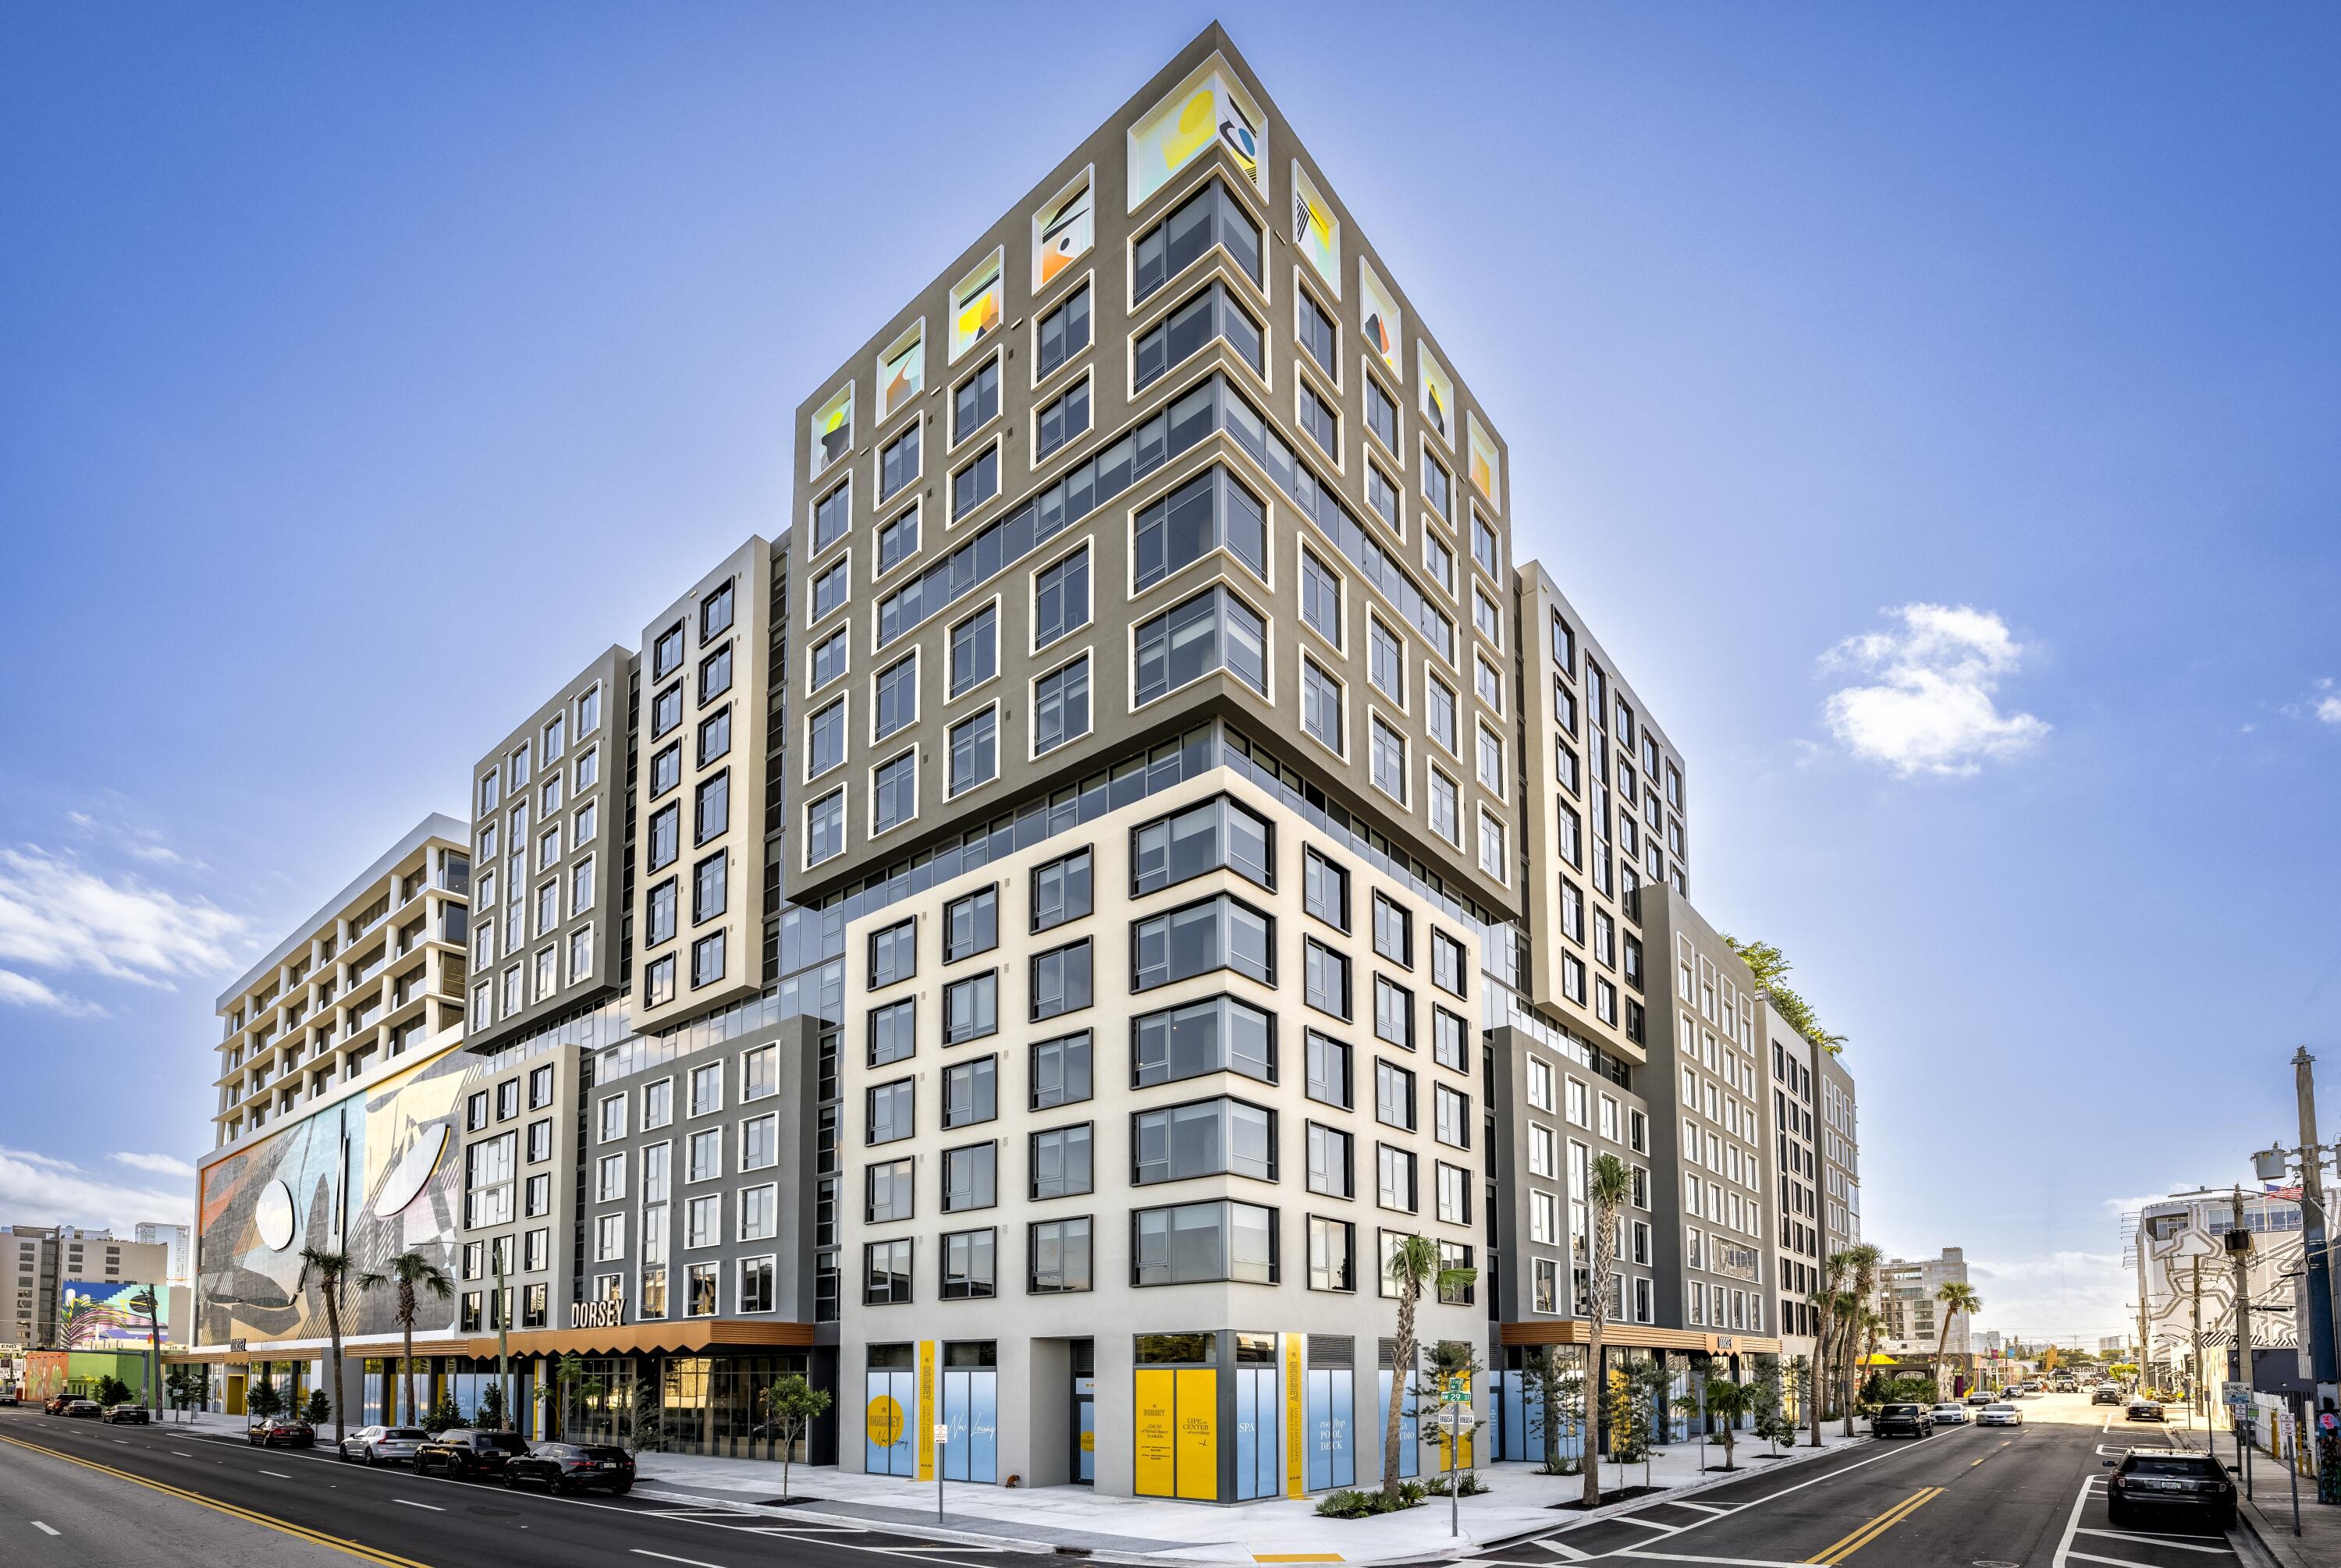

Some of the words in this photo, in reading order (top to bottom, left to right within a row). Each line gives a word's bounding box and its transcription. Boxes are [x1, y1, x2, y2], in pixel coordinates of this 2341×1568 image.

[571, 1299, 627, 1328] DORSEY
[1290, 1361, 1298, 1402] DORSEY
[869, 1415, 901, 1428] DORSEY
[948, 1413, 968, 1439] Now
[970, 1412, 996, 1442] Leasing
[1238, 1422, 1255, 1432] SPA
[1320, 1418, 1345, 1429] rooftop
[1320, 1430, 1341, 1439] POOL
[1320, 1441, 1342, 1451] DECK
